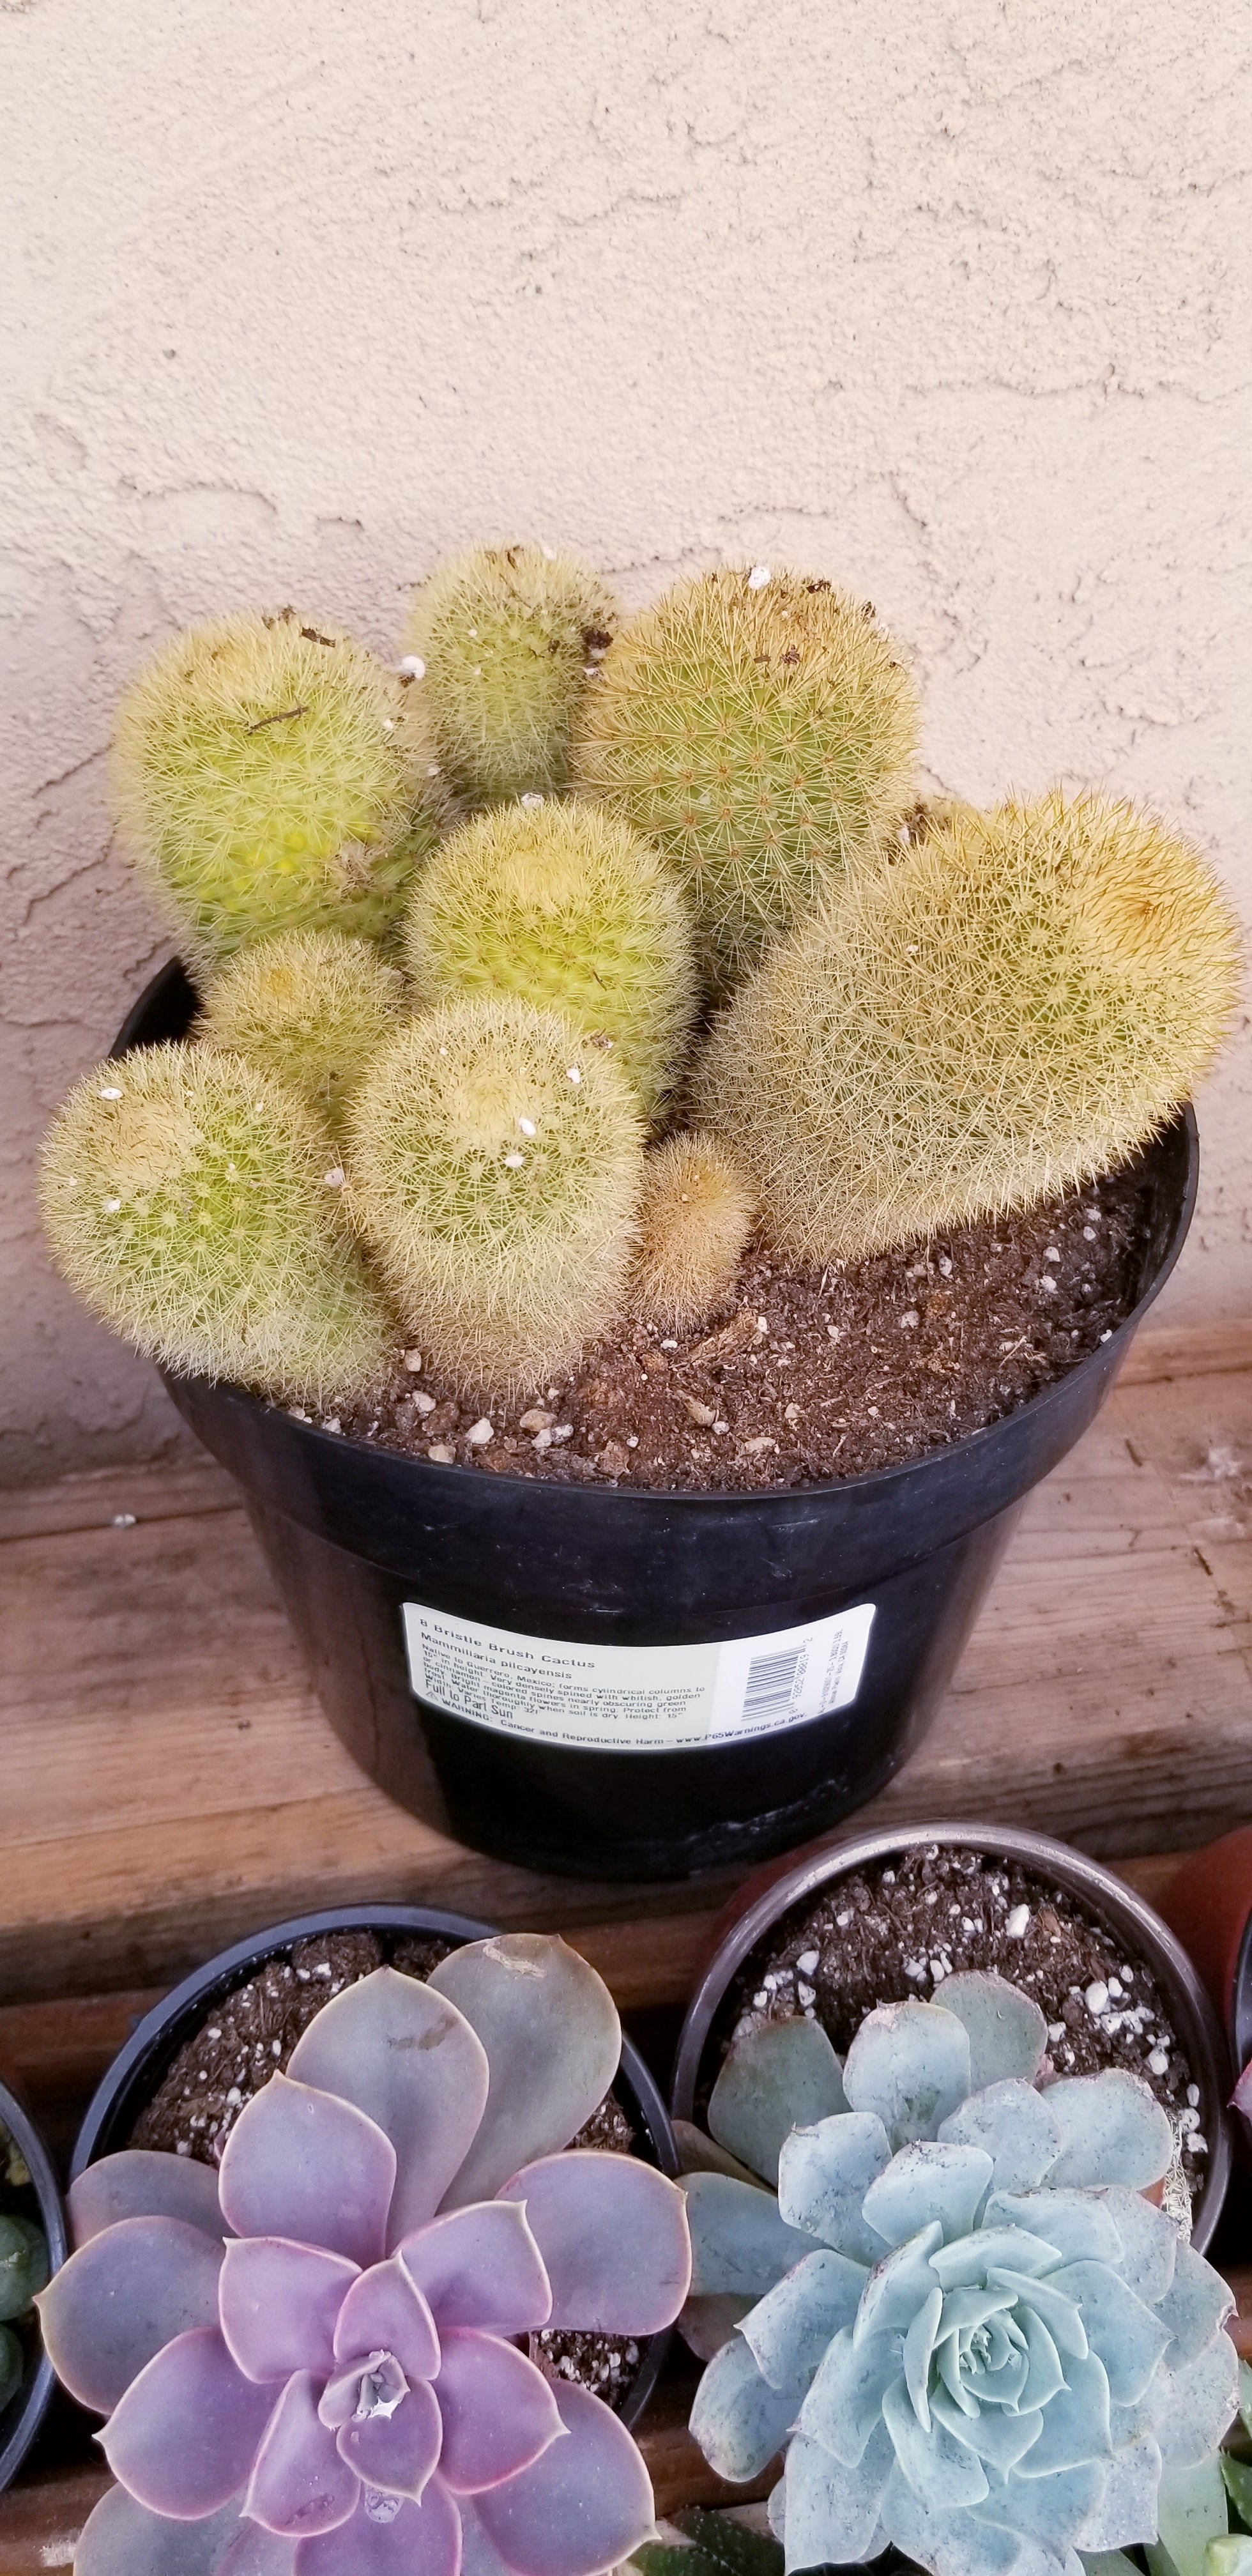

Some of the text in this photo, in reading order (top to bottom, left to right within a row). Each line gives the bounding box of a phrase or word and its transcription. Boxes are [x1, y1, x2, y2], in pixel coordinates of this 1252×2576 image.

[420, 1619, 595, 1668] 8 Bristle Brush Cactus
[422, 1632, 572, 1679] Mammillaria pilcayensis
[422, 1644, 450, 1659] Native
[559, 1683, 588, 1692] forms
[649, 1686, 692, 1694] columns
[425, 1679, 513, 1719] Full to Part Sun
[452, 1679, 478, 1692] Water
[483, 1690, 535, 1708] thoroughly
[458, 1687, 485, 1701] Varies
[484, 1685, 526, 1700] magenta
[530, 1696, 565, 1708] flowers
[491, 1675, 512, 1685] Very
[516, 1682, 554, 1694] densely
[557, 1690, 592, 1698] spined
[666, 1693, 701, 1701] golden
[531, 1691, 564, 1701] spines
[441, 1698, 493, 1722] WARNING:
[501, 1719, 535, 1733] Cancer
[539, 1729, 558, 1738] and
[562, 1733, 631, 1745] Reproductive
